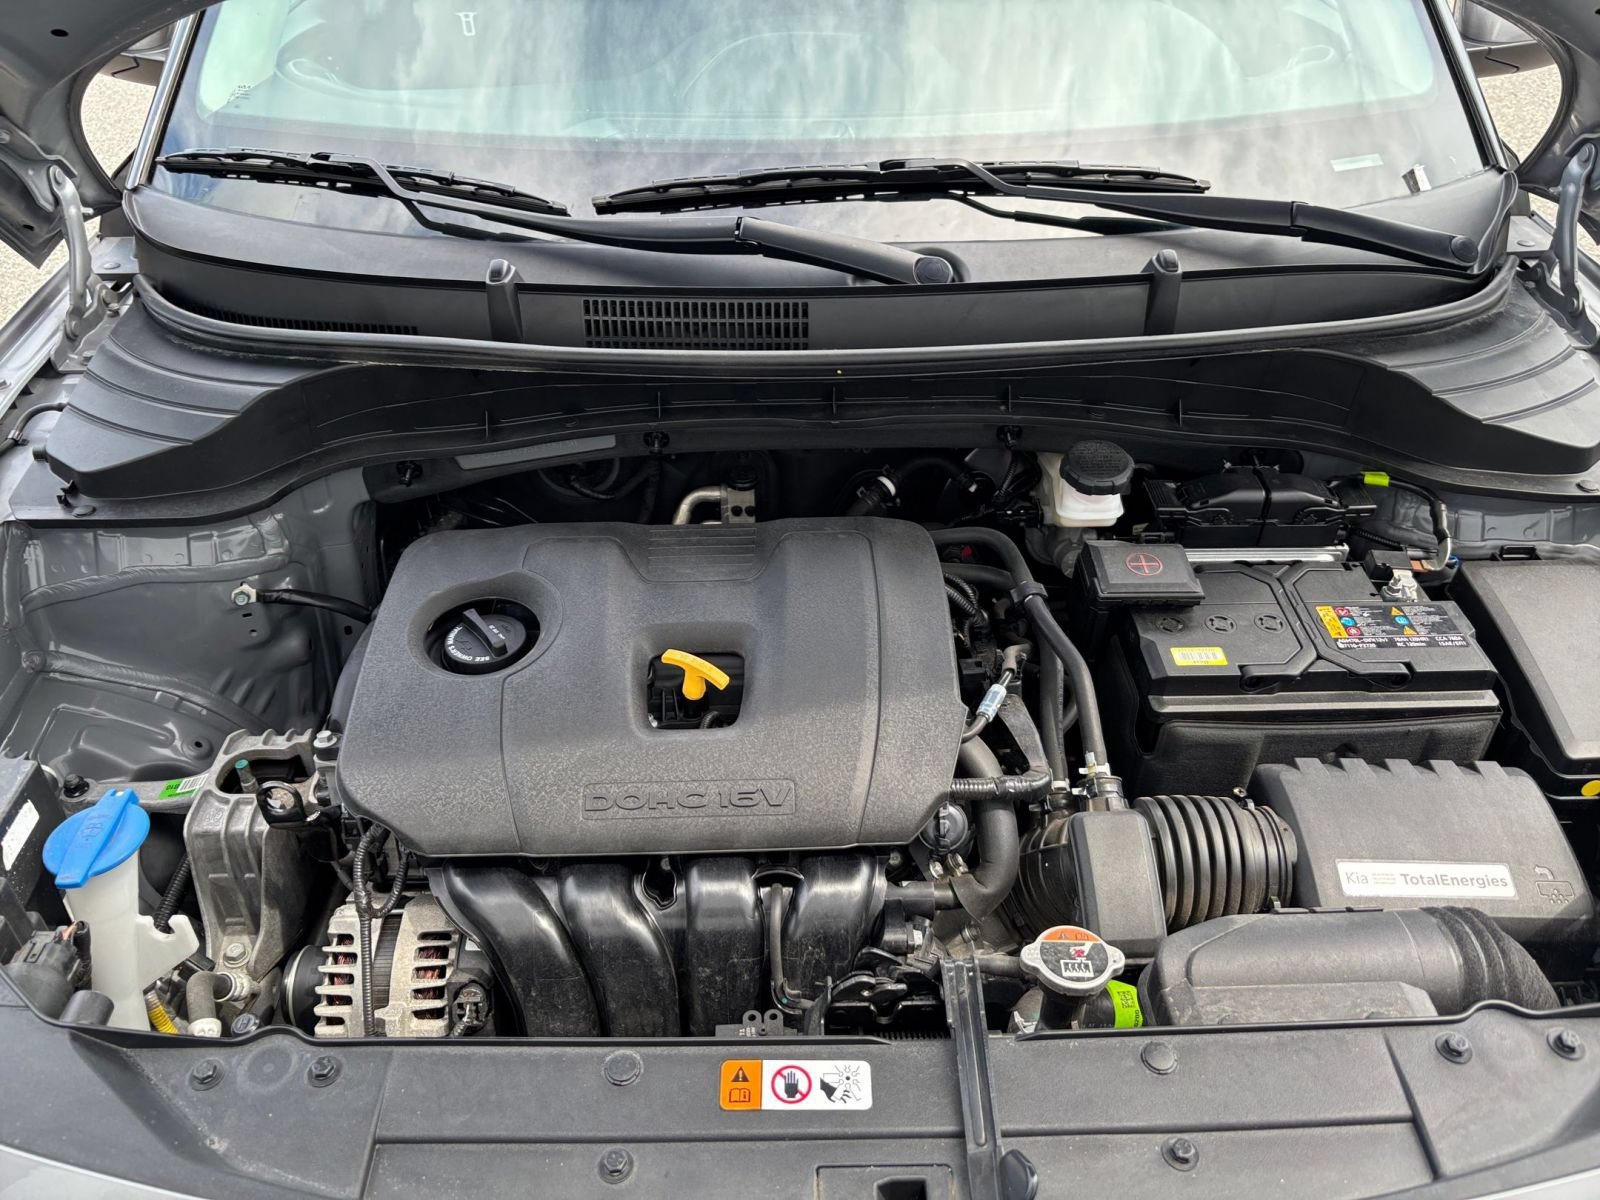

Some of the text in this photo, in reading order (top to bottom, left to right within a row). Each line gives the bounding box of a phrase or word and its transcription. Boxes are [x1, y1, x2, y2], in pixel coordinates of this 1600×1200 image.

[584, 787, 792, 812] DOHC 16V
[1344, 871, 1508, 889] Kia TotalEnergies
